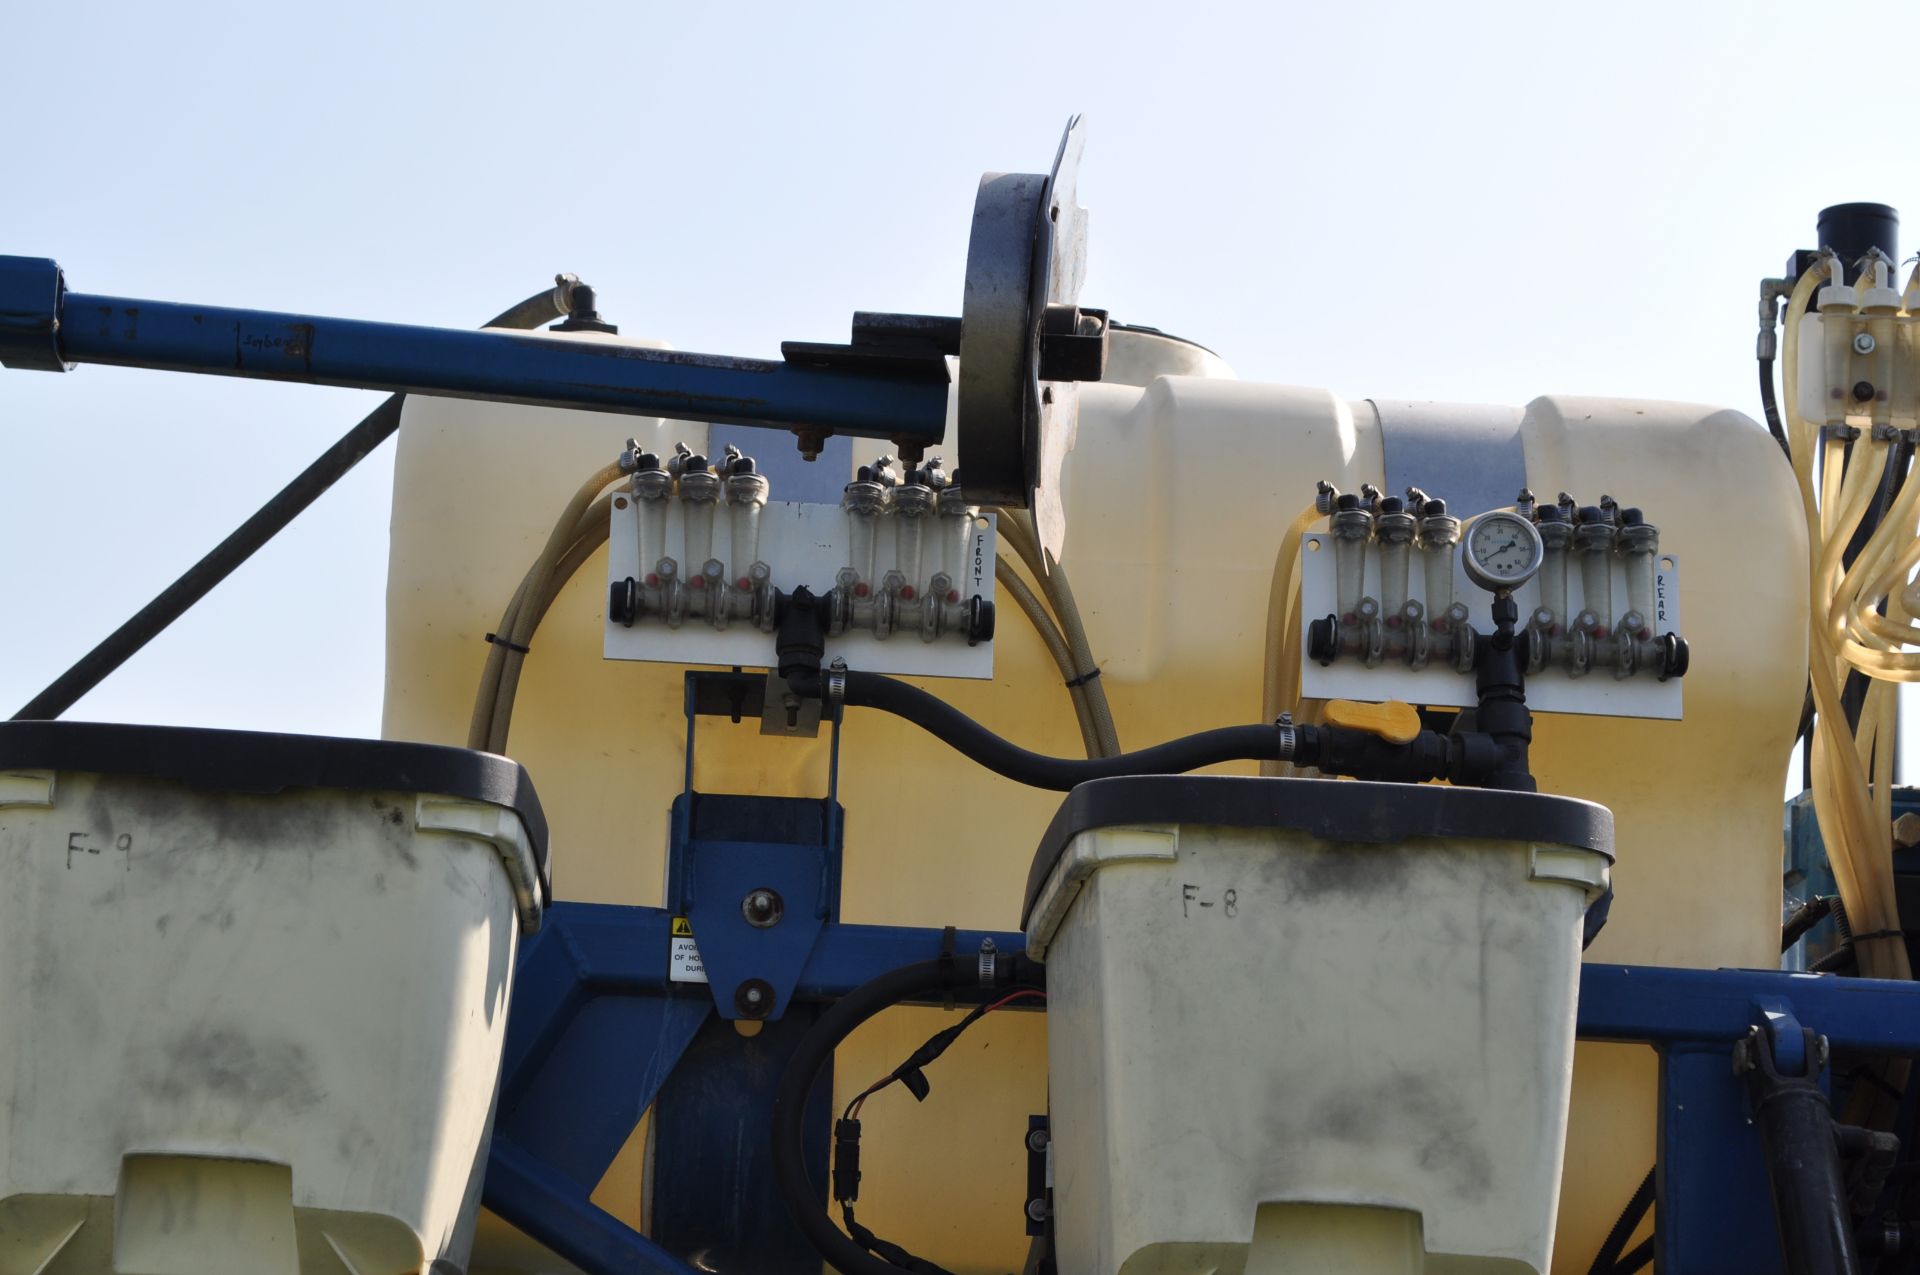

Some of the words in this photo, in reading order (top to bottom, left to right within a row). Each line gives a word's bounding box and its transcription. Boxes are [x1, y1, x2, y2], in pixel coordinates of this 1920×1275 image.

[974, 534, 984, 587] FRONT
[1657, 575, 1667, 621] REAR
[66, 832, 132, 872] F-9
[1182, 883, 1238, 918] F-8
